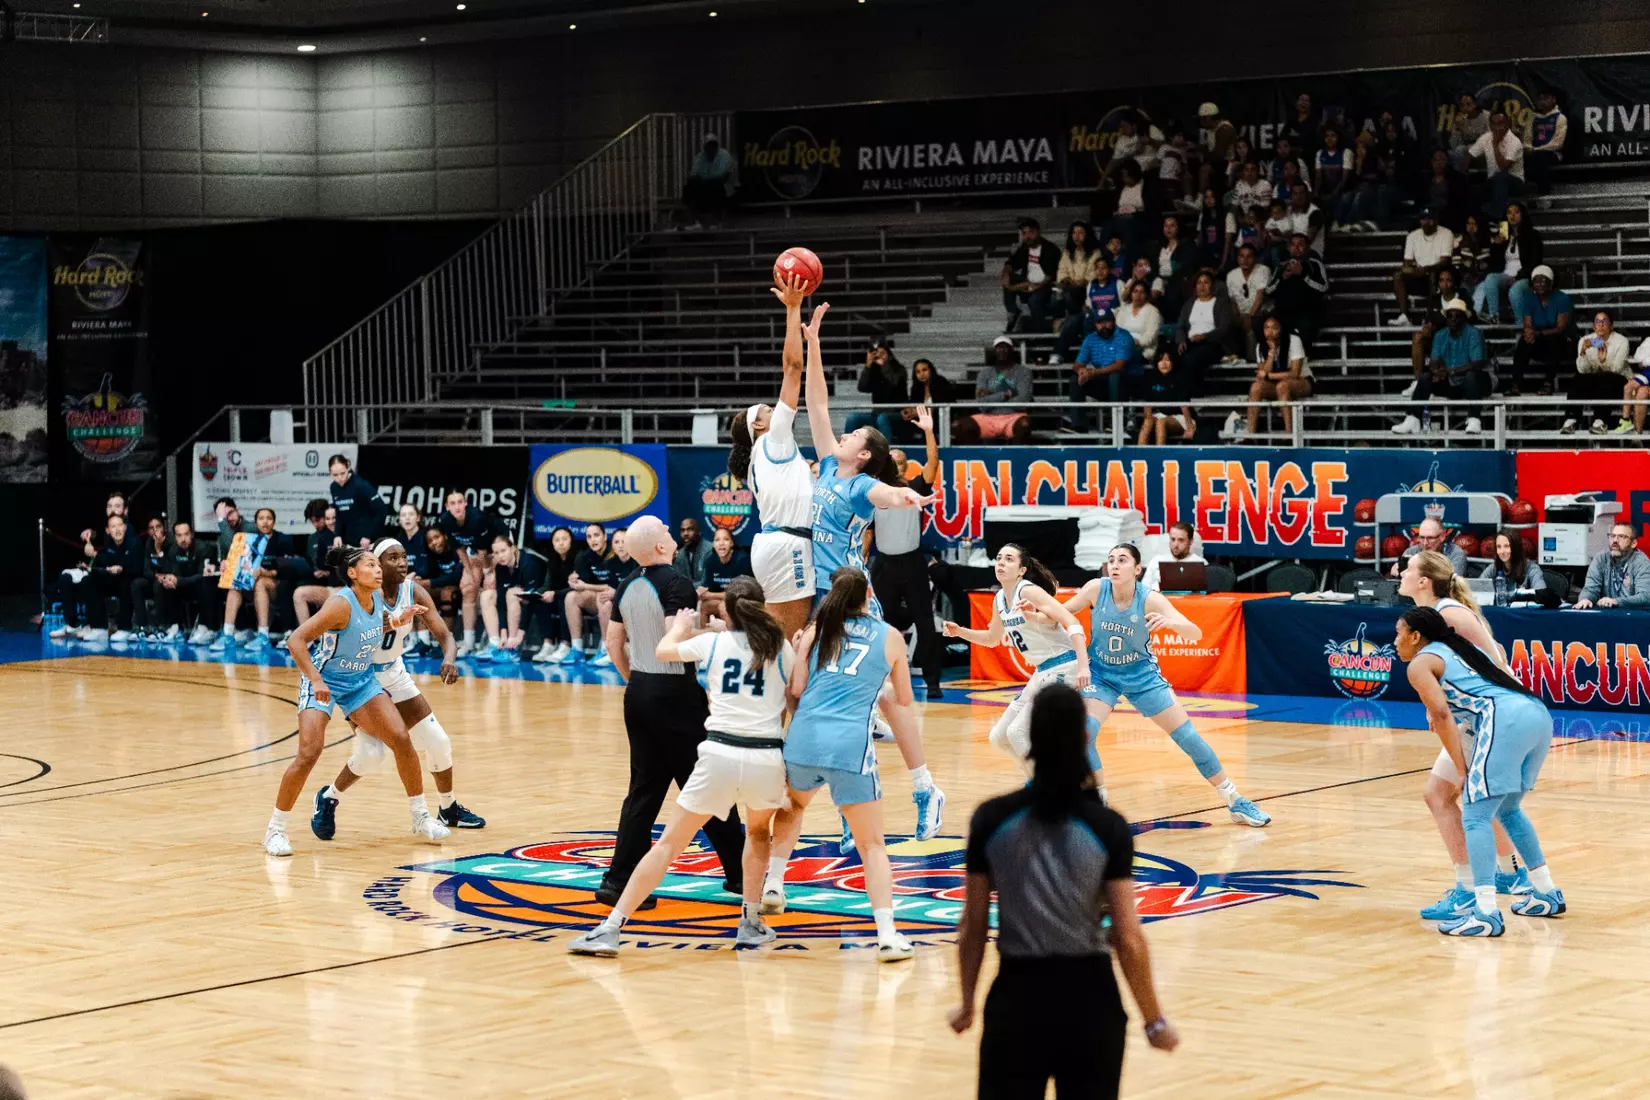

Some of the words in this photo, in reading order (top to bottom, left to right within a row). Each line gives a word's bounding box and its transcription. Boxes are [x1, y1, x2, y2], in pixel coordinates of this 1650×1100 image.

[743, 141, 789, 167] Hard
[794, 138, 842, 169] Rock
[857, 142, 965, 171] RIVIERA
[972, 137, 1055, 165] MAYA
[1590, 142, 1612, 157] AN
[861, 179, 880, 190] AN
[883, 176, 971, 190] ALL-INCLUSIVE
[974, 171, 1050, 186] EXPERIENCE
[53, 264, 101, 285] Hard
[103, 264, 144, 288] Rock
[73, 427, 137, 437] CHALLENGE
[547, 473, 641, 496] BUTTERBALL
[377, 485, 518, 516] FLOHOPS
[1026, 460, 1348, 547] CHALLENGE
[360, 626, 382, 642] NORT
[1100, 621, 1136, 638] NORTH
[1108, 635, 1123, 653] 0
[1169, 648, 1220, 657] EXPERIENCE
[1095, 645, 1140, 665] CAROLINA
[1328, 653, 1392, 673] CANCUN
[721, 658, 765, 696] 24
[1333, 669, 1386, 680] CHALLENGE
